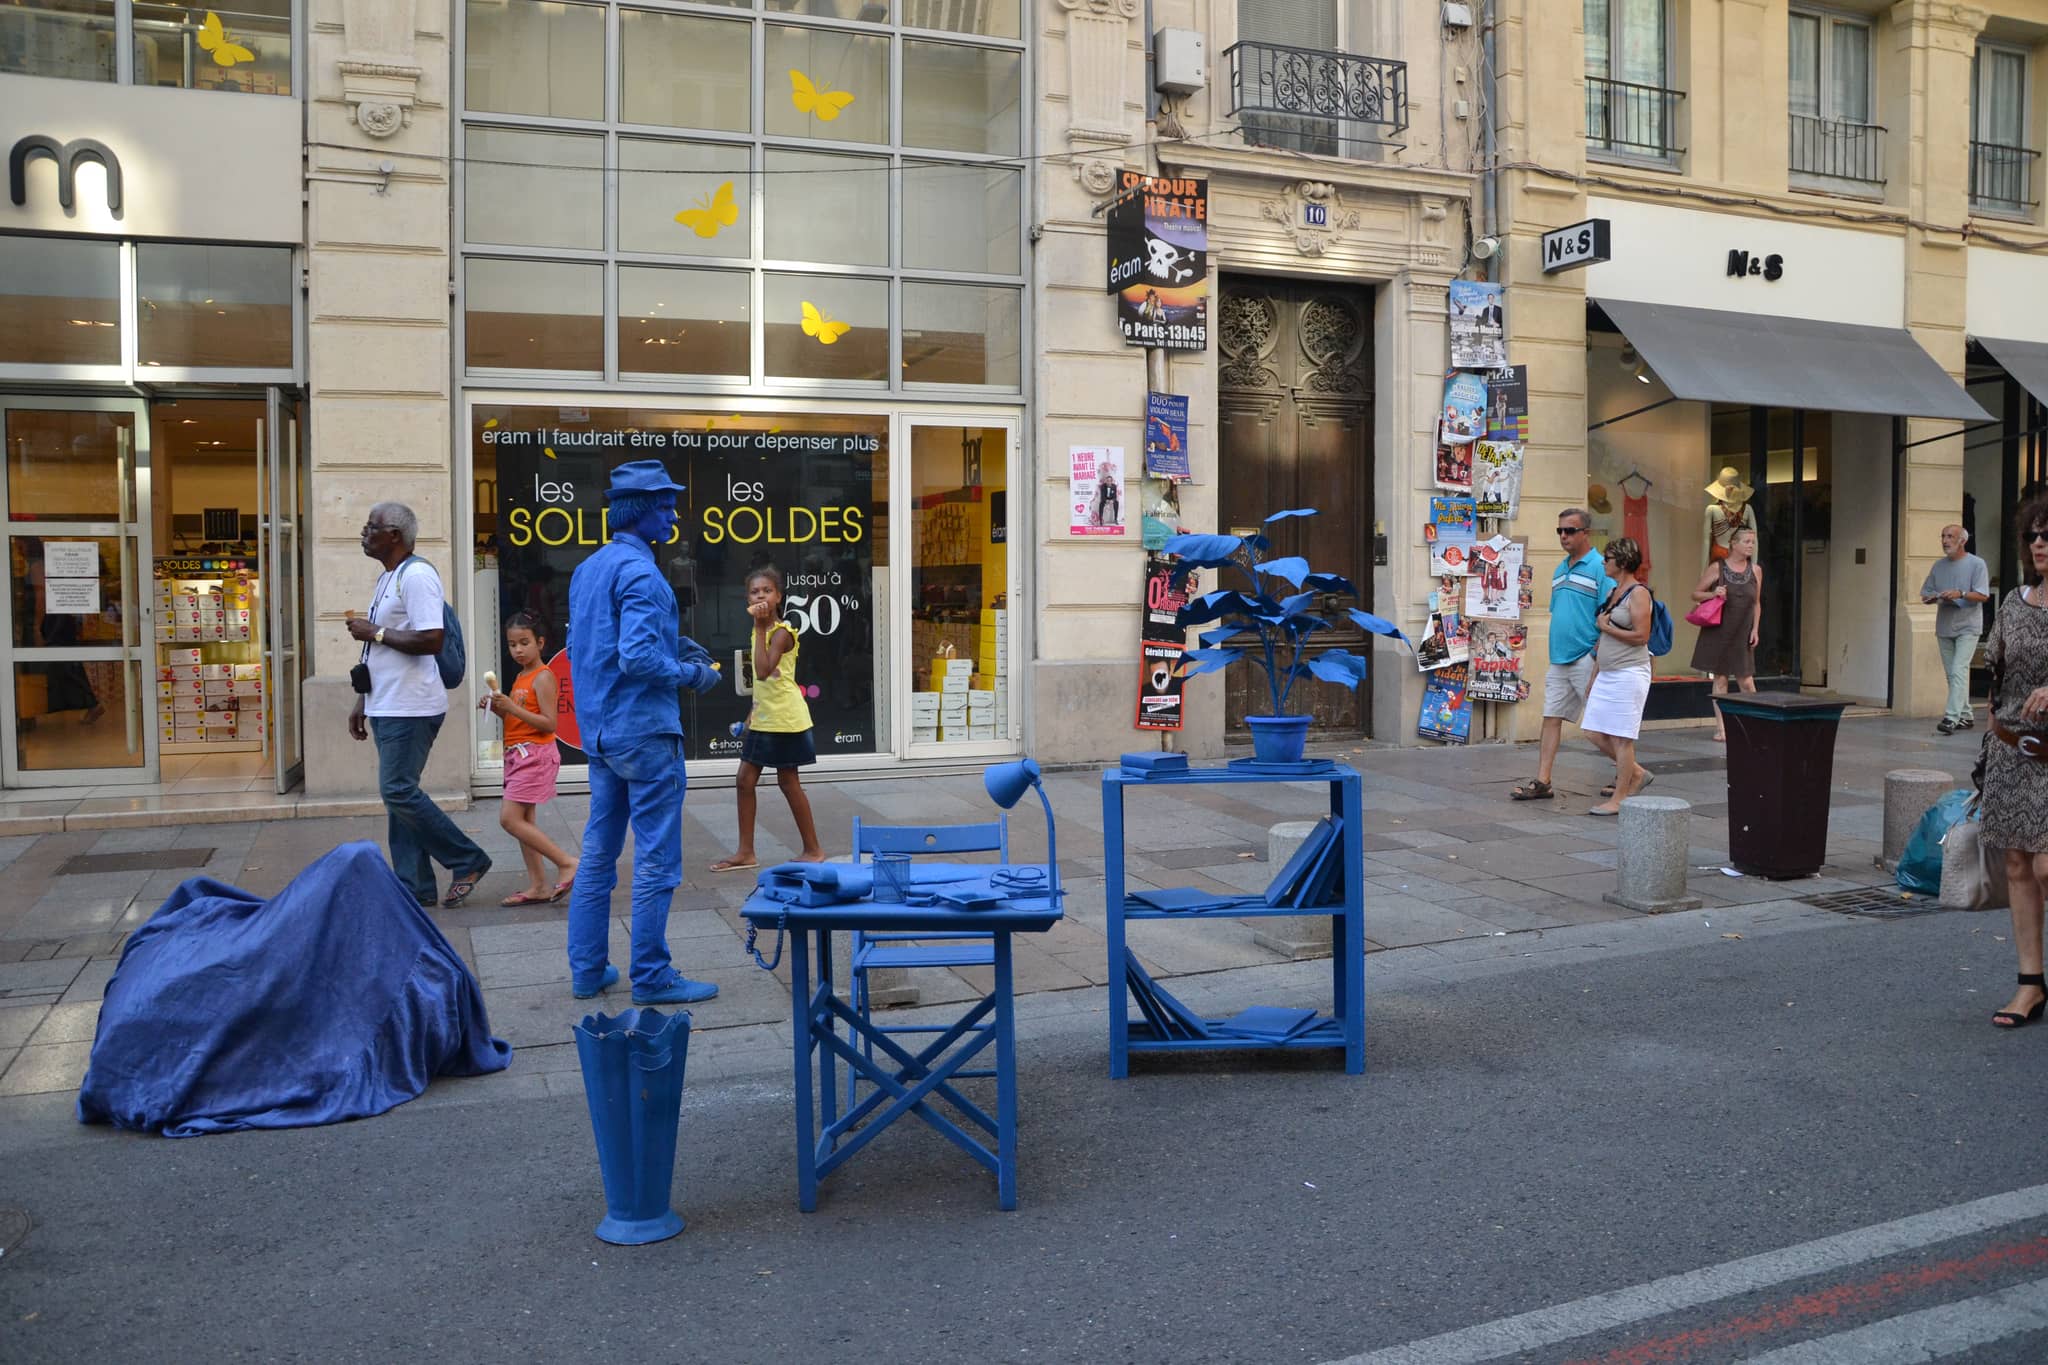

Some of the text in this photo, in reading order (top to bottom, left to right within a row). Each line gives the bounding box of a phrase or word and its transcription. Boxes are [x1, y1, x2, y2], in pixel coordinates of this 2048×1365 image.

[10, 134, 122, 220] m
[1309, 207, 1324, 224] 10
[1110, 258, 1142, 284] éram
[1134, 321, 1206, 341] Paris-13h45
[1151, 396, 1168, 407] DUO
[537, 428, 546, 444] il
[552, 428, 625, 446] faudrait
[630, 429, 666, 447] être
[672, 430, 701, 447] fou
[707, 434, 749, 451] pour
[843, 435, 880, 453] plus
[535, 472, 575, 503] les
[727, 472, 765, 502] les
[509, 507, 681, 546] SOL
[703, 506, 864, 544] SOLDES
[162, 560, 201, 570] SOLDES
[785, 571, 842, 588] jusqu'à
[709, 737, 744, 750] é-shop
[834, 732, 862, 743] éram
